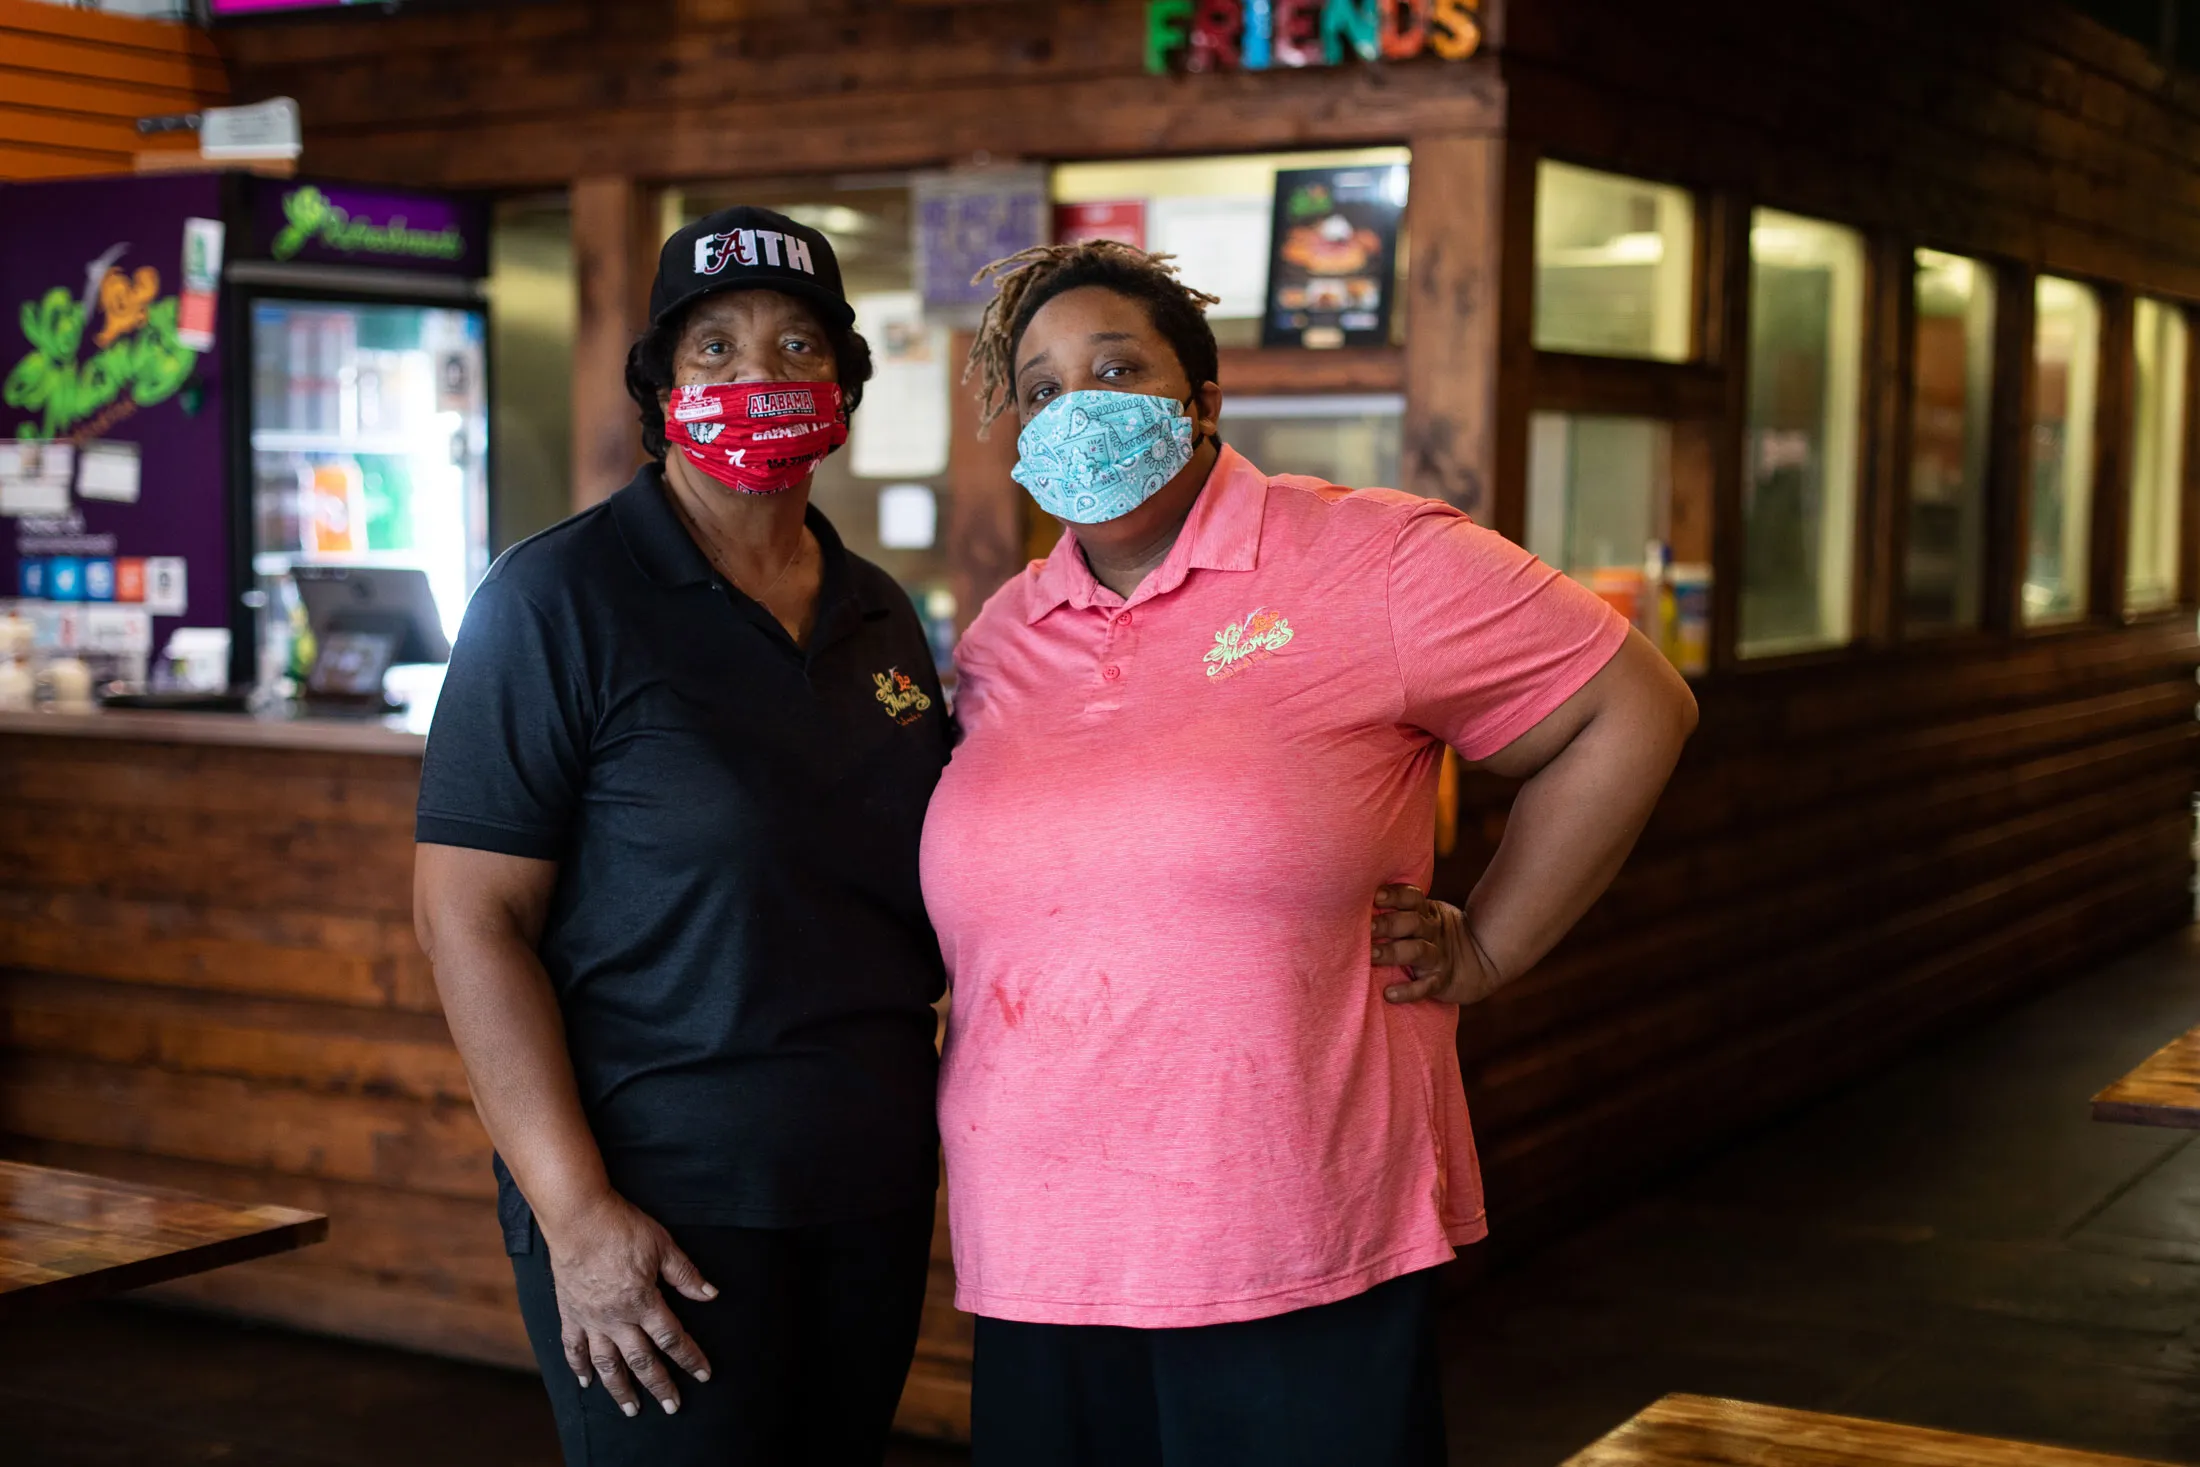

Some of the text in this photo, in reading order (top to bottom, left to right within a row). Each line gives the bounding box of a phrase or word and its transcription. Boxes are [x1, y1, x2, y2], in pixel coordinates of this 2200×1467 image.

[1144, 0, 1480, 74] FRIENDS
[694, 228, 815, 275] FAITH
[750, 391, 813, 413] ALABAMA
